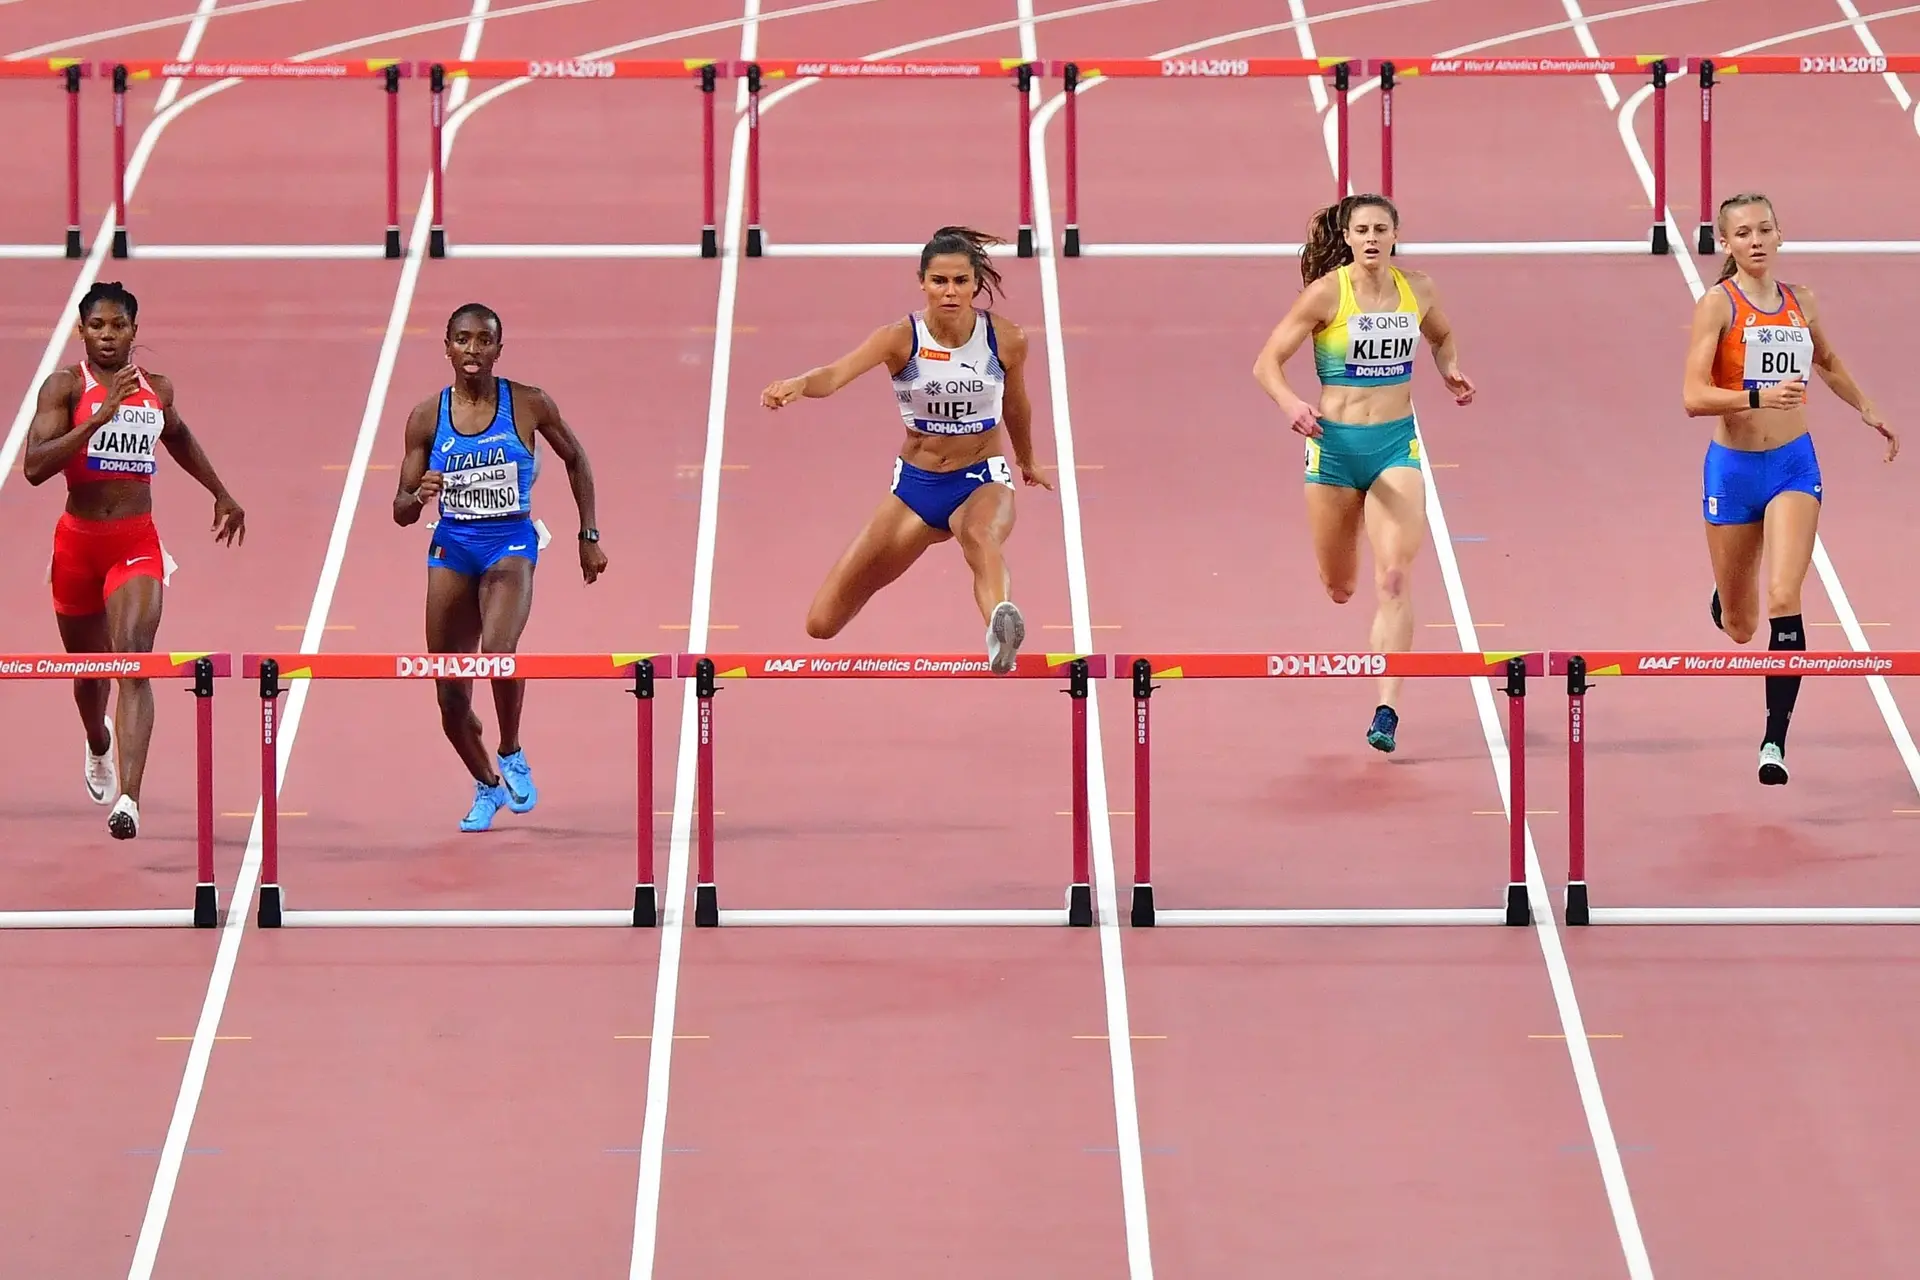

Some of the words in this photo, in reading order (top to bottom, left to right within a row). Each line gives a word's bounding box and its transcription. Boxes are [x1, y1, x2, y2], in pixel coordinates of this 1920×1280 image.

[527, 60, 616, 77] DOHA2019
[829, 63, 860, 74] World
[860, 63, 903, 75] Athletics
[904, 63, 981, 76] Championships
[1161, 59, 1250, 77] DOHA2019
[1430, 60, 1462, 72] IAAF
[1463, 60, 1494, 71] World
[1495, 60, 1538, 72] Athletics
[1539, 59, 1615, 73] Championships
[1800, 57, 1887, 73] DOHA2019
[1376, 316, 1409, 329] QNB
[1774, 329, 1804, 342] QNB
[1353, 338, 1413, 360] KLEIN
[1355, 365, 1405, 377] DOHA2019
[1762, 352, 1801, 374] BOL
[945, 380, 984, 394] QNB
[123, 409, 156, 424] QNB
[926, 421, 984, 434] DOHA2019
[100, 460, 153, 473] DOHA2019
[445, 447, 506, 472] ITALIA
[36, 659, 141, 674] Championships
[396, 656, 516, 677] DOHA2019
[763, 658, 807, 672] IAAF
[809, 658, 851, 672] World
[852, 658, 911, 672] Athletics
[913, 658, 1017, 674] Championss
[1267, 654, 1387, 676] DOHA2019
[1638, 656, 1682, 670] IAAF
[1683, 656, 1725, 670] World
[1726, 656, 1786, 670] Athletics
[1787, 656, 1894, 672] Championships
[264, 708, 272, 744] MONDO
[1138, 708, 1146, 744] MONDO
